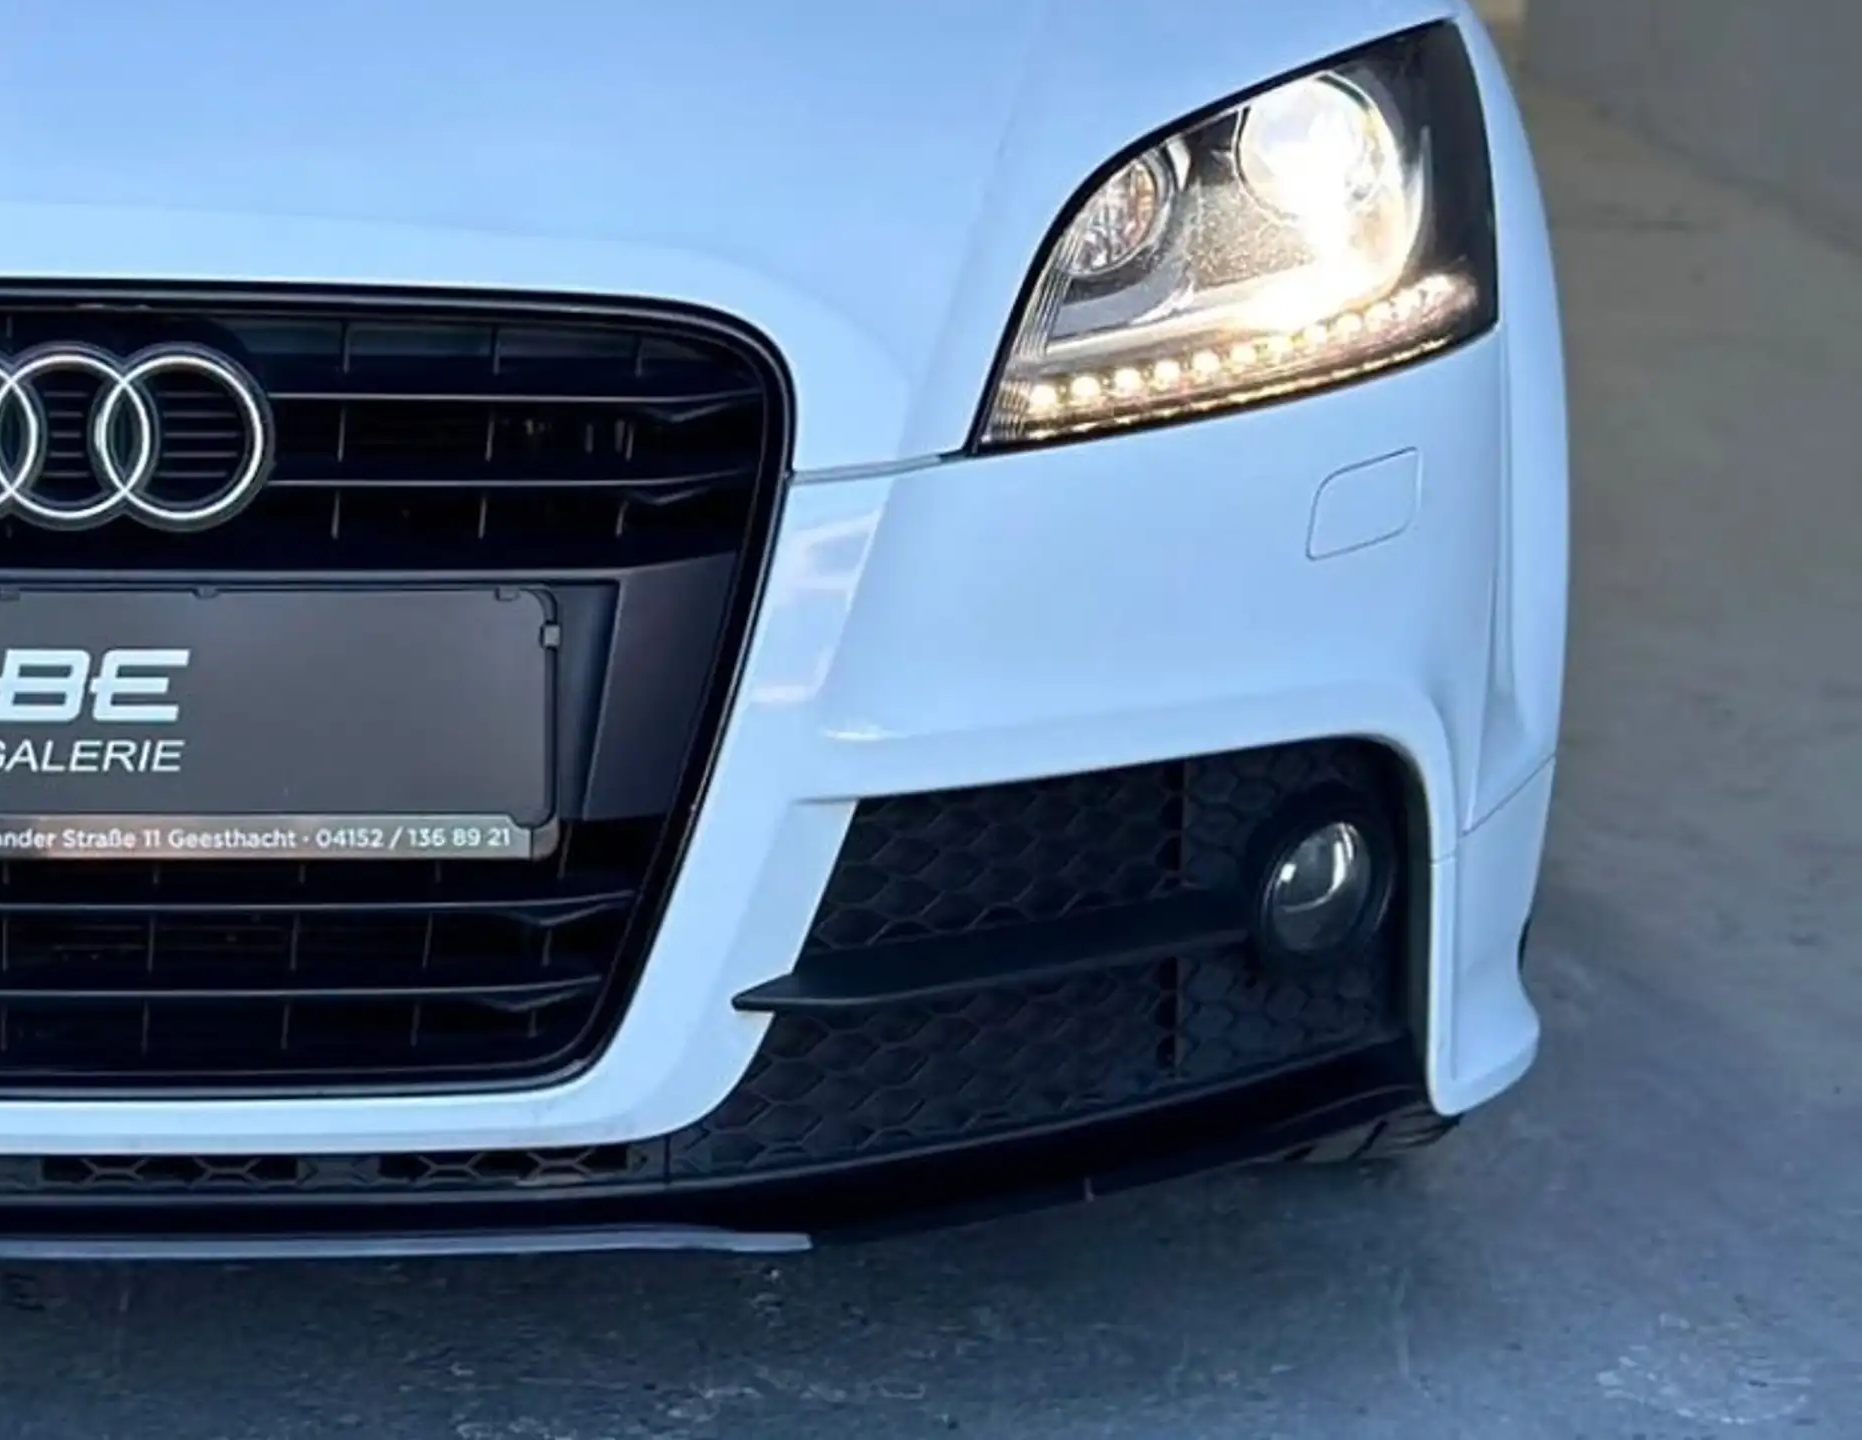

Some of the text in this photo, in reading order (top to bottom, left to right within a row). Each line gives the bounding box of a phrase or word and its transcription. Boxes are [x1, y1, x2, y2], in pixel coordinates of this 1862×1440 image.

[61, 828, 137, 850] Straße
[142, 828, 162, 849] 11
[167, 827, 297, 850] Geesthacht
[315, 827, 385, 849] 04152
[407, 827, 446, 848] 136
[452, 827, 482, 848] 89
[487, 827, 512, 847] 21
